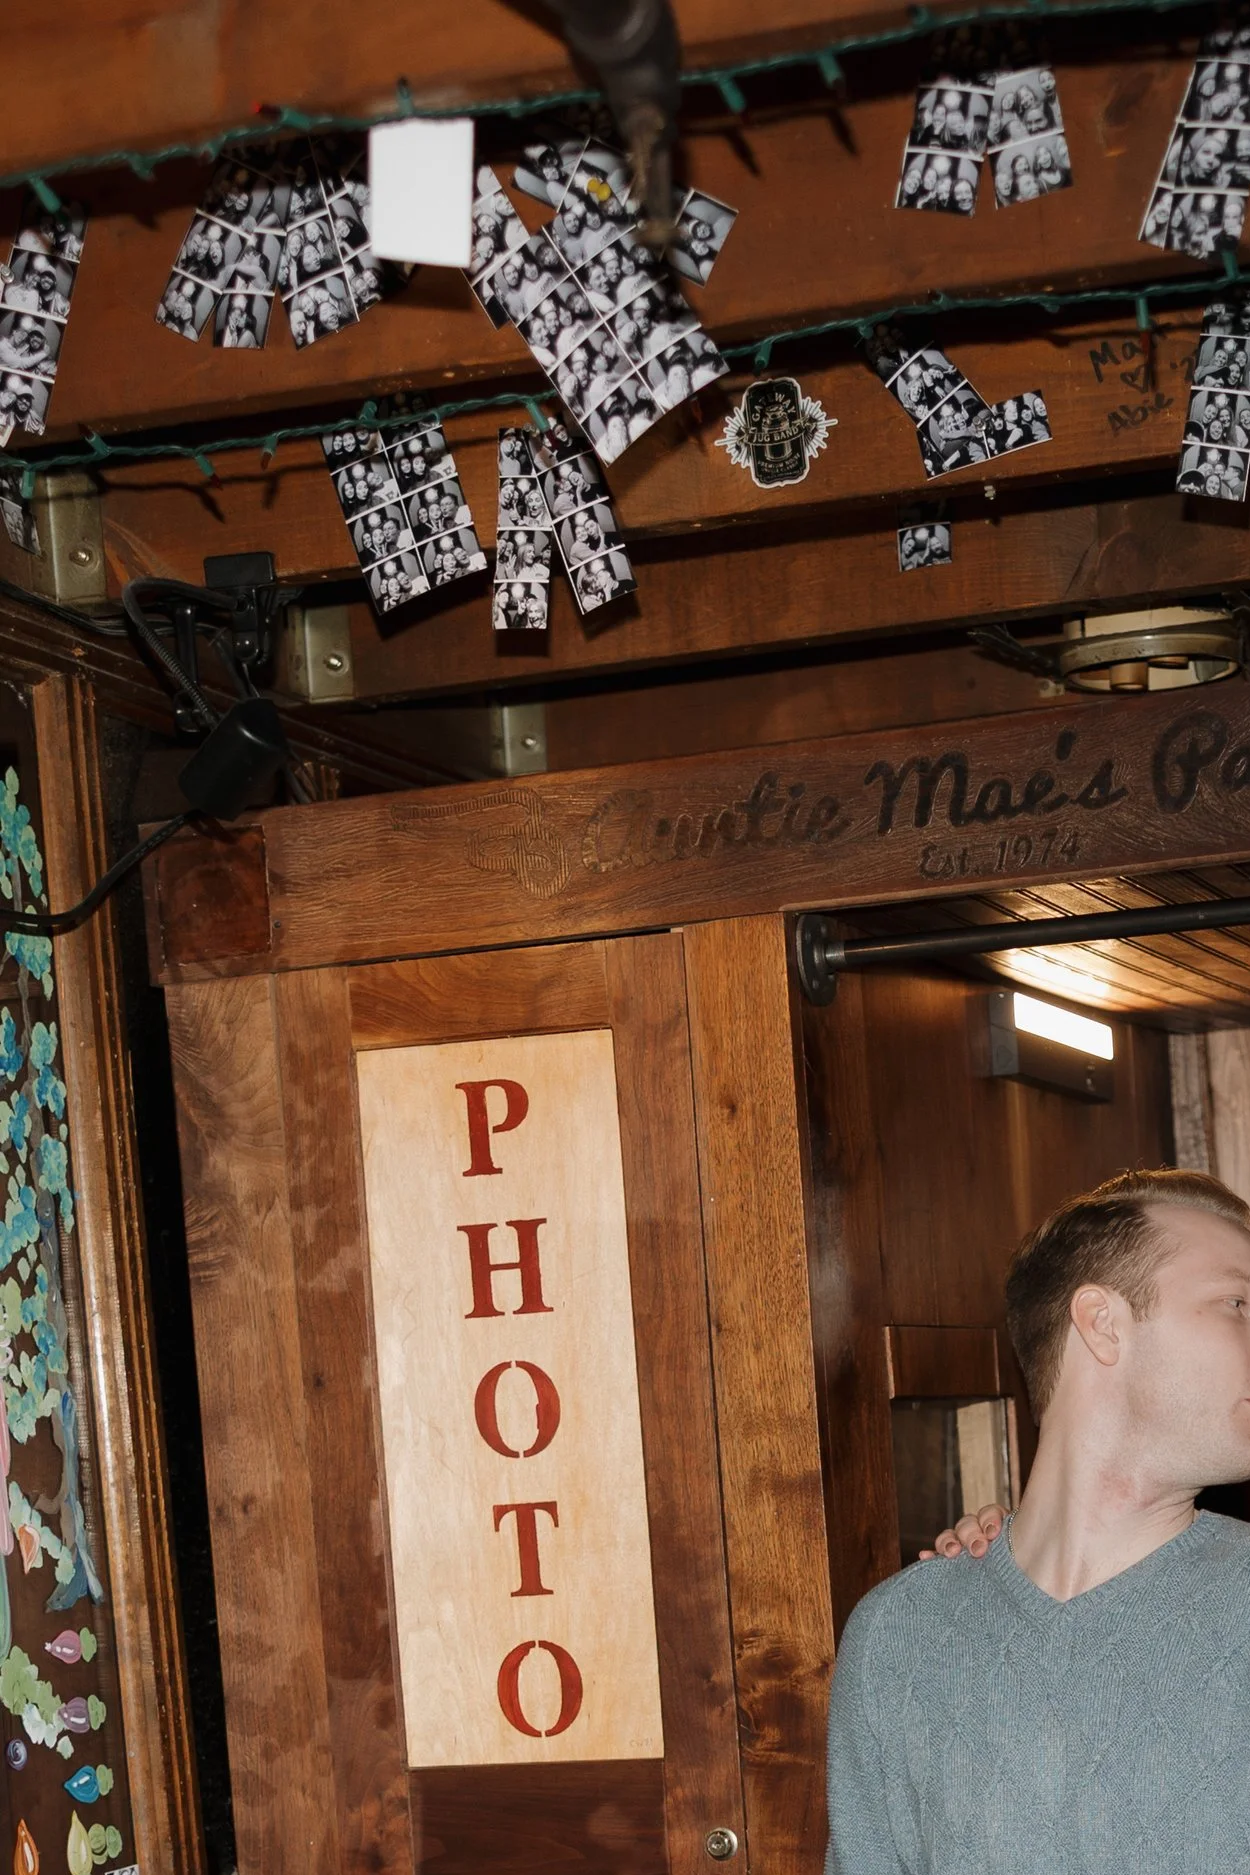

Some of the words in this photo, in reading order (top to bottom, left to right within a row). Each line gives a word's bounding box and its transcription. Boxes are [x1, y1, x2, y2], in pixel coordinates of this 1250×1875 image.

[751, 391, 797, 422] GATEWAY
[752, 431, 771, 443] JUG
[773, 425, 799, 441] BAND
[582, 768, 852, 875] Auntie
[864, 727, 1127, 837] Mae's
[918, 841, 982, 881] Est.
[993, 825, 1081, 873] 1974
[455, 1077, 584, 1739] PHOTO
